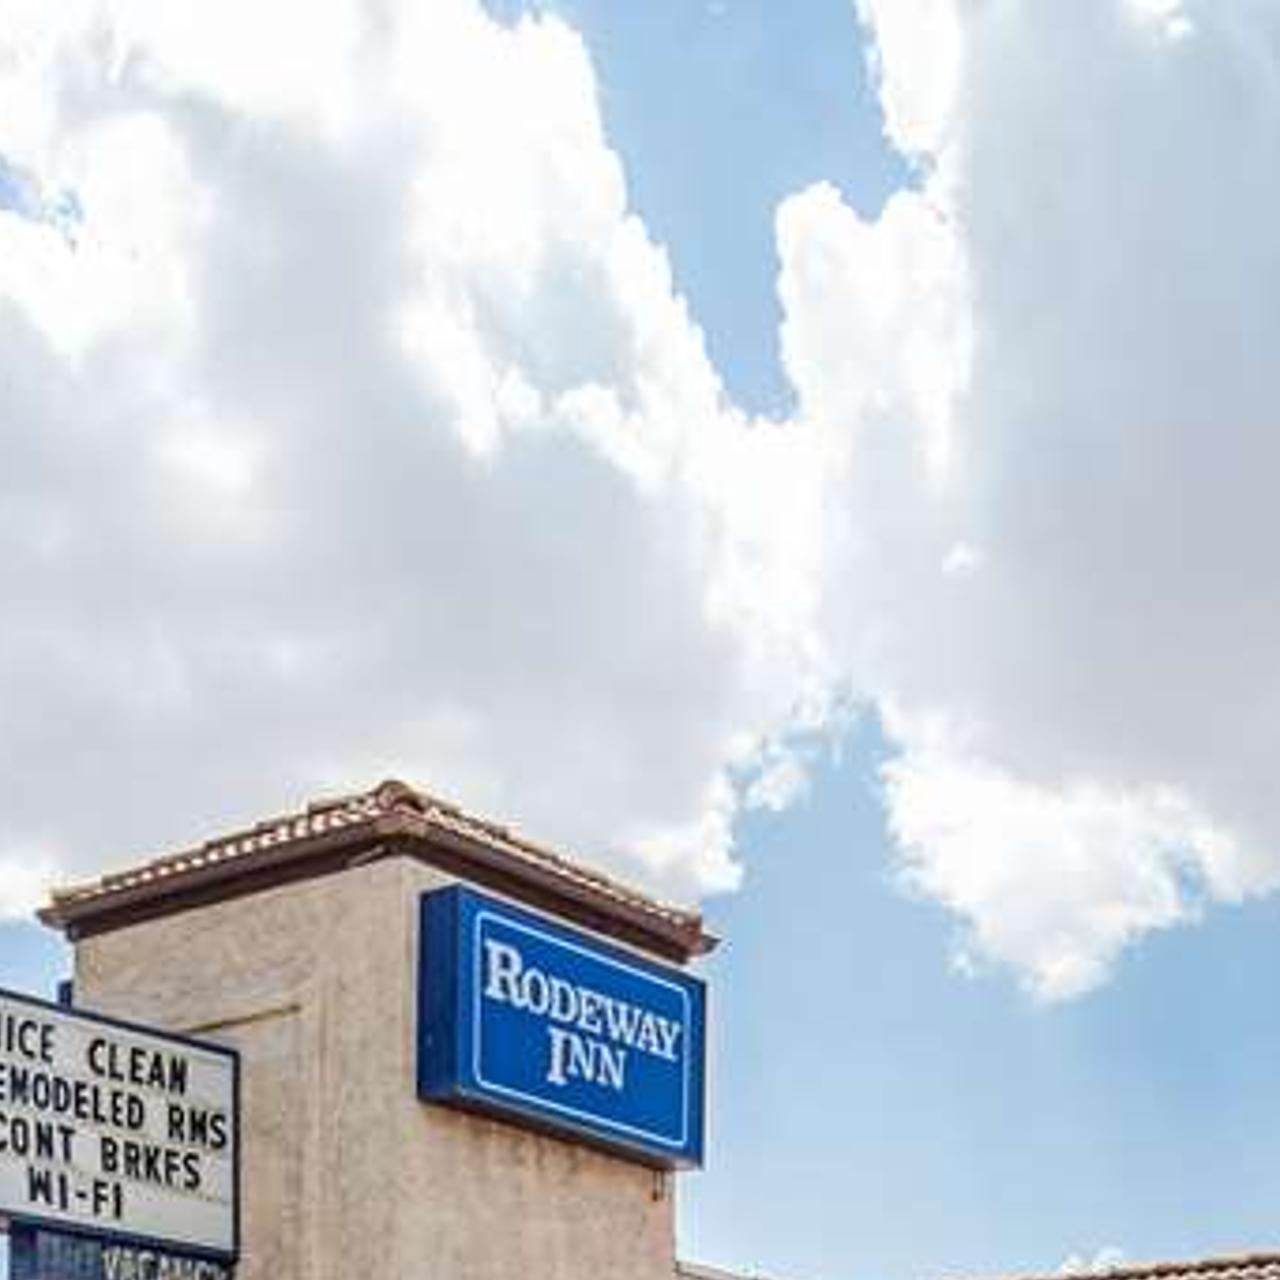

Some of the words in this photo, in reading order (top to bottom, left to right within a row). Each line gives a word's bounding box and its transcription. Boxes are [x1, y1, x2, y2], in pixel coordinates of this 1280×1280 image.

[483, 937, 682, 1063] RODEWAY
[88, 1037, 189, 1096] CLEAN
[546, 1025, 626, 1091] INN
[167, 1104, 227, 1150] RMS
[101, 1136, 201, 1190] BRKFS
[27, 1166, 122, 1219] WI-FI
